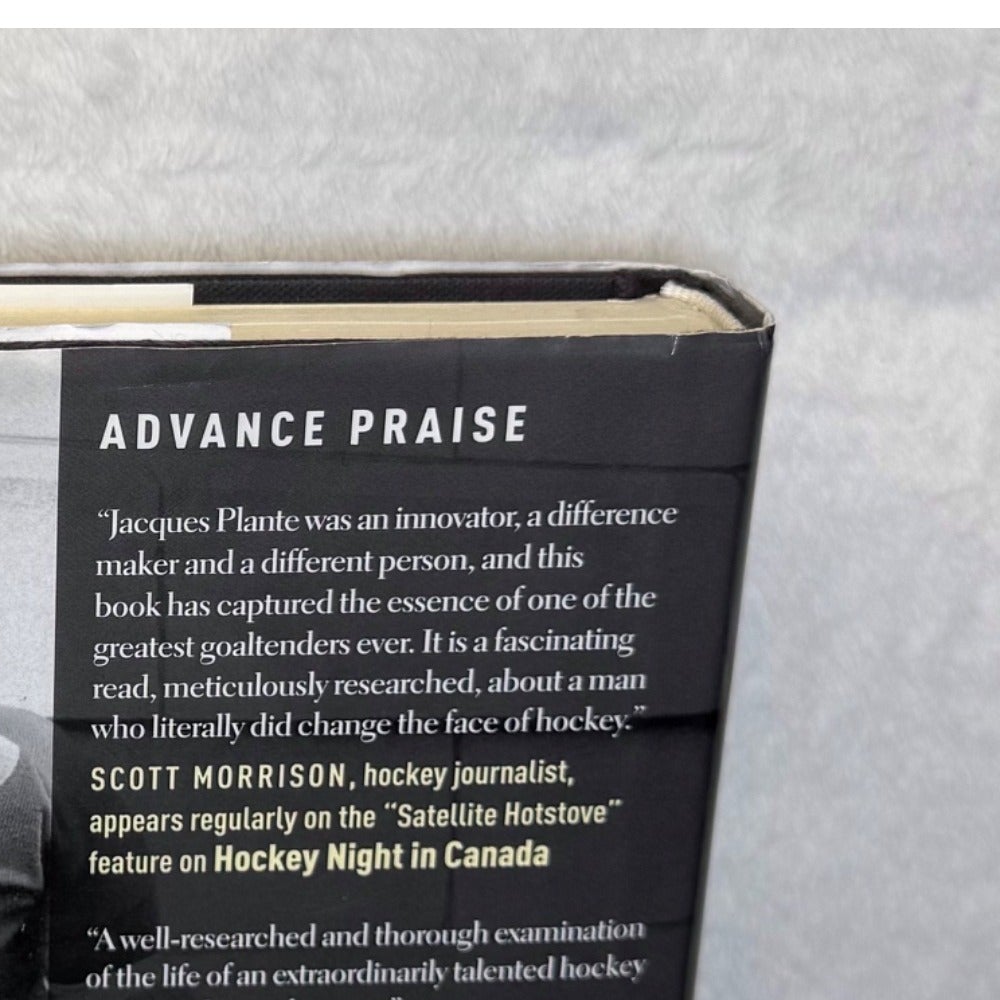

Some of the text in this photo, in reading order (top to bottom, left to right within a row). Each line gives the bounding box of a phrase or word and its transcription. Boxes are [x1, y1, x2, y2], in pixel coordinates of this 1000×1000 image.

[101, 406, 524, 449] ADVANCE PRAISE
[98, 499, 679, 540] “Jacques Plante was an innovator, a difference
[95, 542, 584, 578] maker and a different person, and this
[95, 583, 656, 622] book has captured the essence of one of the
[92, 625, 636, 666] greatest goaltenders ever. It is a fascinating
[92, 667, 647, 703] read, meticulously researched, about a man
[90, 705, 647, 744] who literally did change the face of hockey.”
[90, 759, 575, 791] SCOTT MORRISON, hockey journalist,
[89, 799, 622, 837] appears regularly on the “Satellite Hotstove”
[87, 839, 551, 877] feature on Hockey Night in Canada
[86, 919, 644, 951] “A well-researched and thorough examination
[85, 953, 646, 990] of the life of an extraordinarily talented hockey
